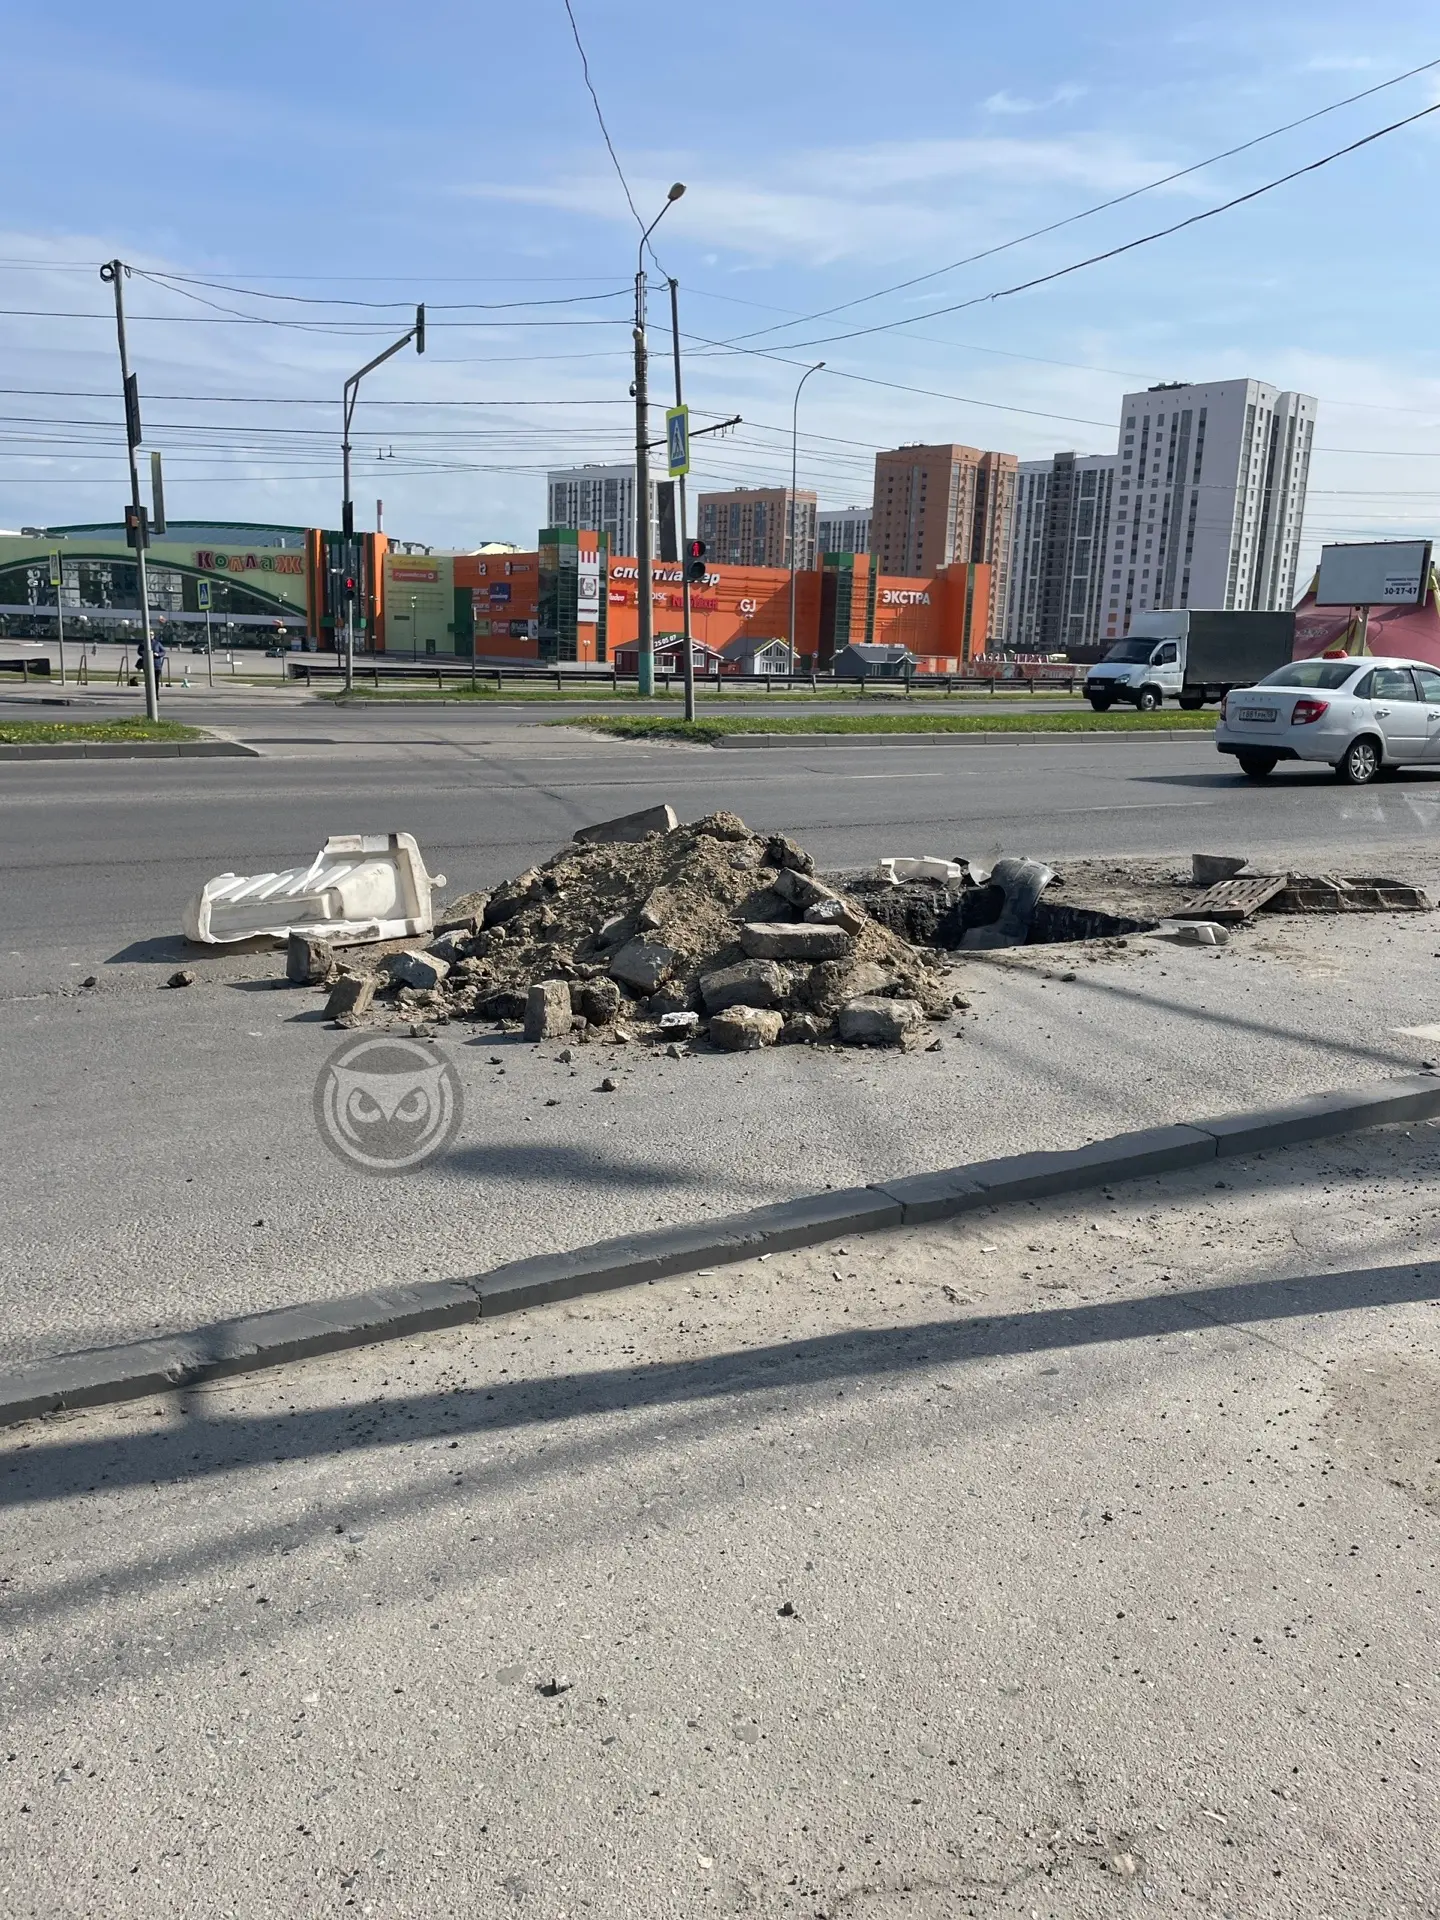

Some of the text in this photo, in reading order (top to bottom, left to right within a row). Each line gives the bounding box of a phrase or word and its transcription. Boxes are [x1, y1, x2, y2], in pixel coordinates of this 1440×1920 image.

[882, 590, 931, 605] ЭКСТРА
[1384, 587, 1417, 595] 30-27-47
[740, 598, 756, 612] GJ
